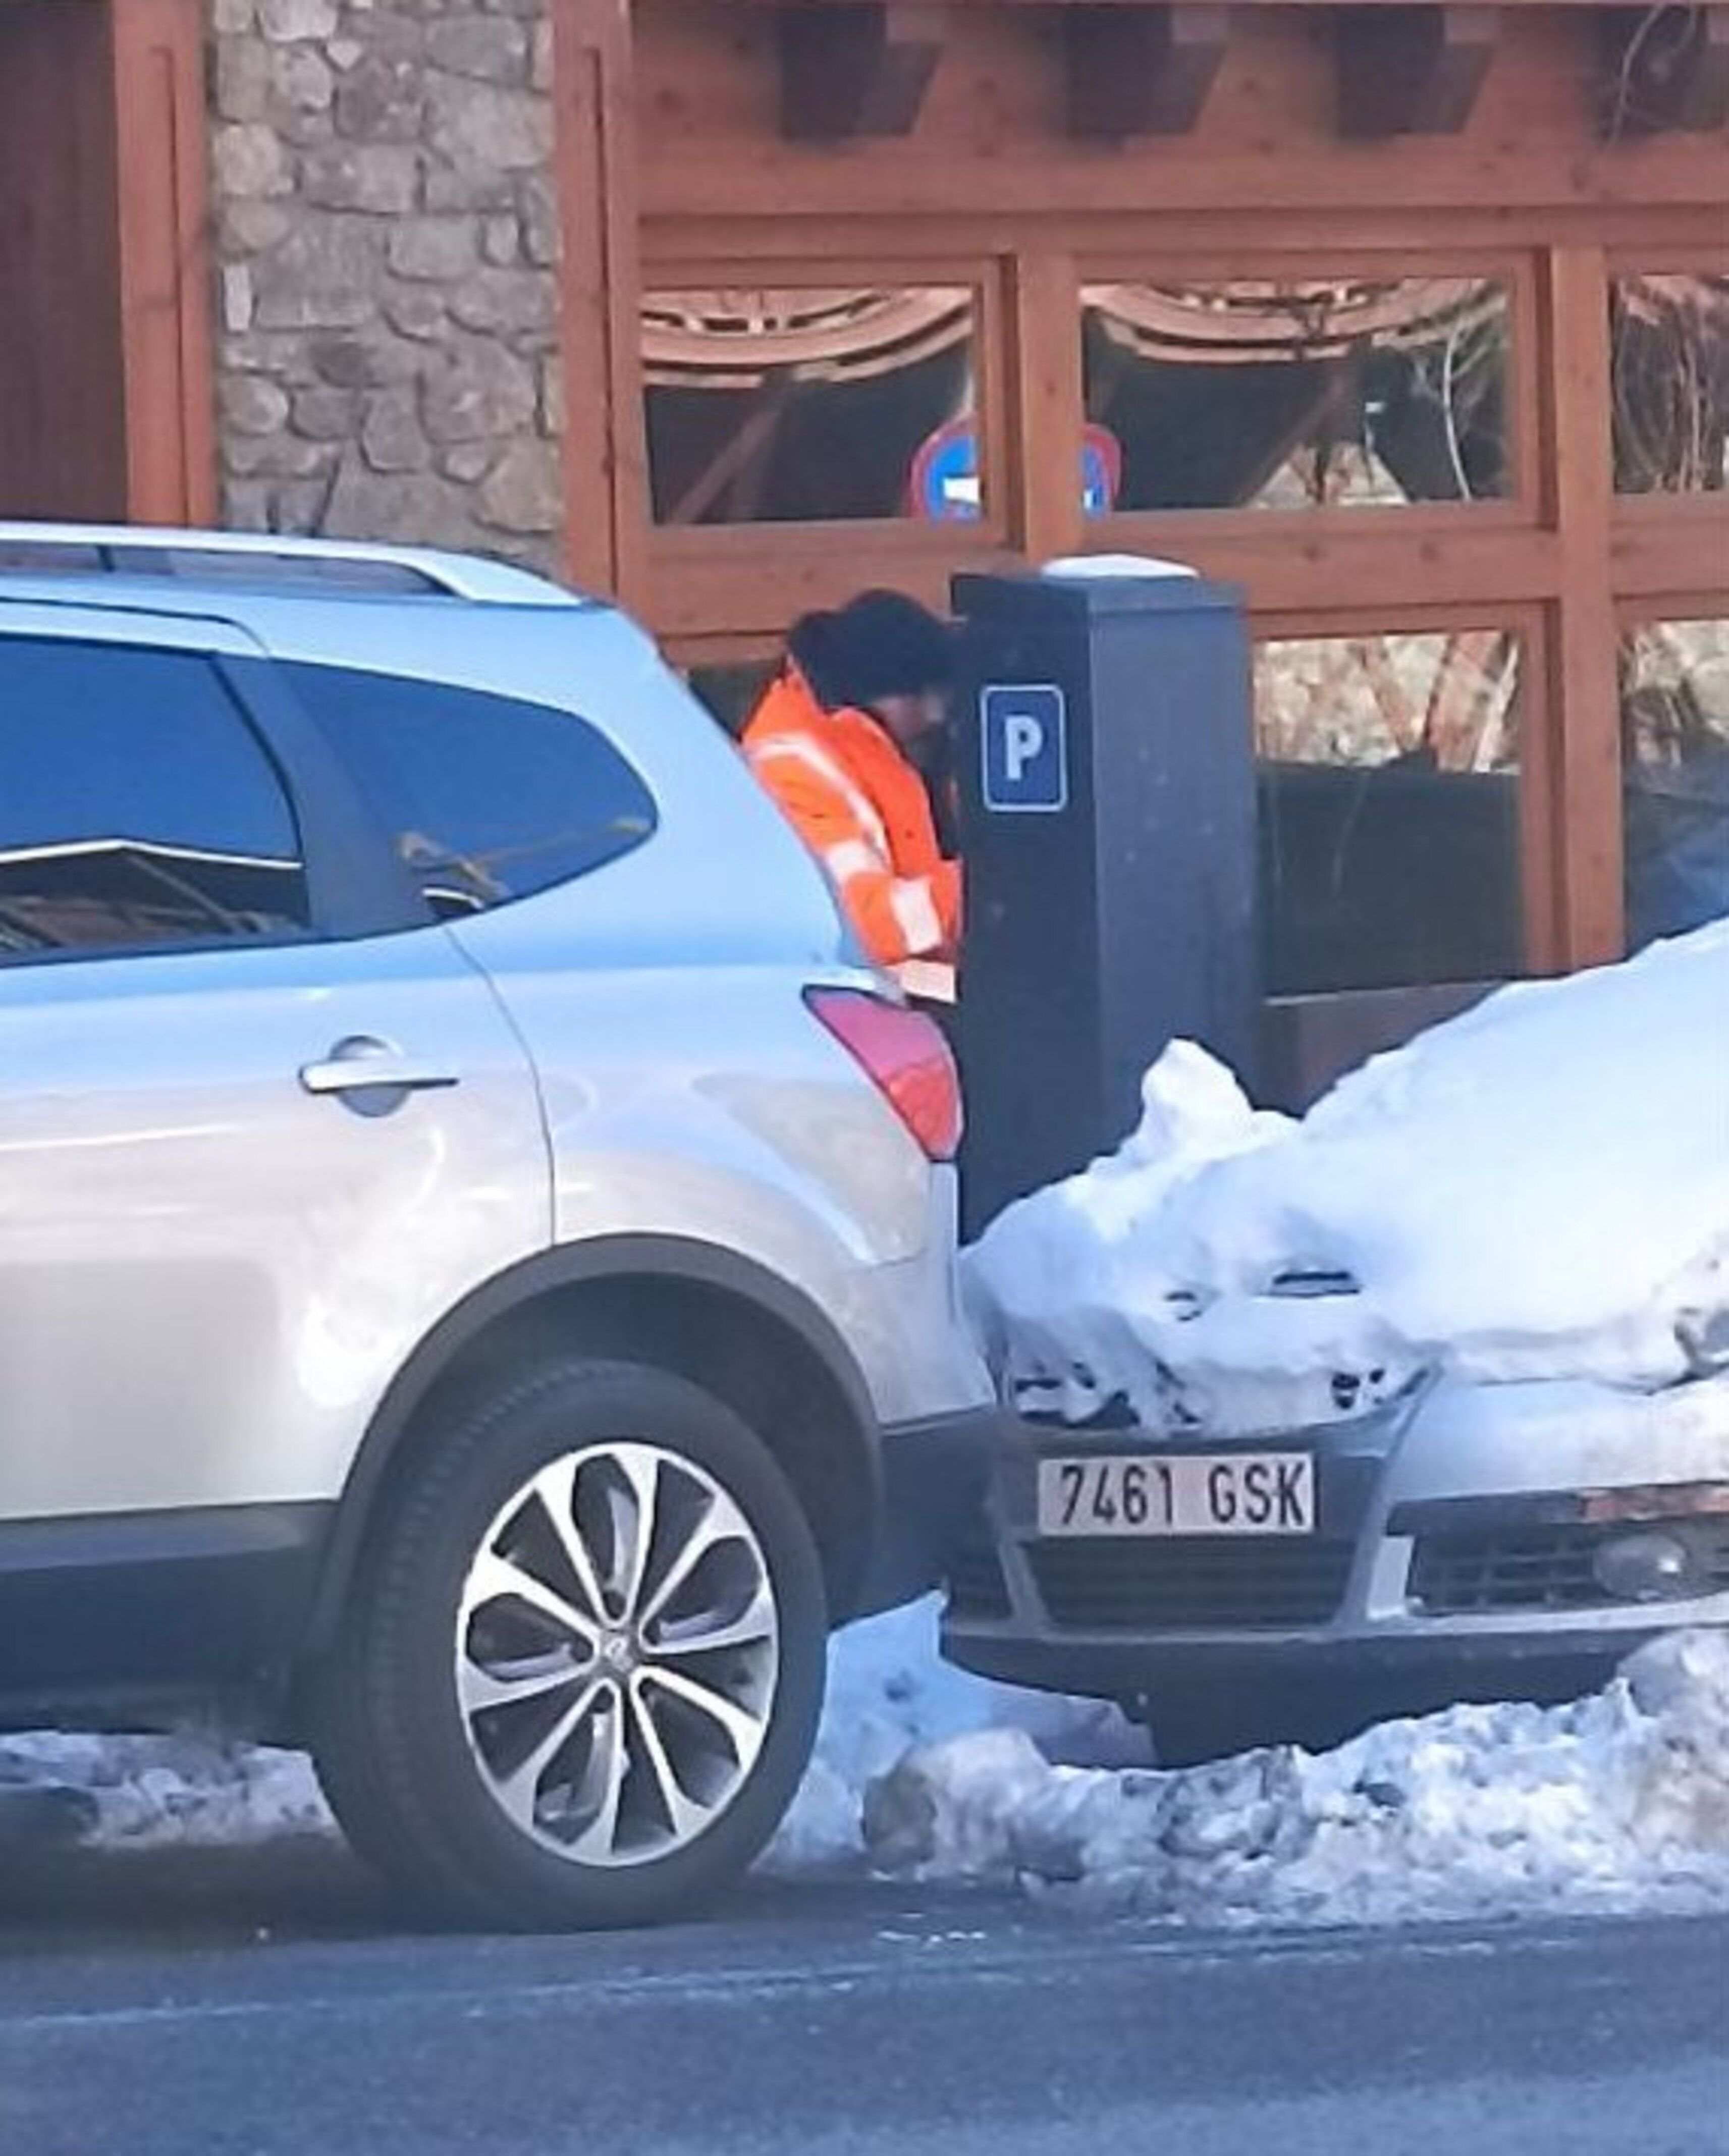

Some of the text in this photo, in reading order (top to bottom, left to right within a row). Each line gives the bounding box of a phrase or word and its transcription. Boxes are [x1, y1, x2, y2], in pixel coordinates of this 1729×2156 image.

[1005, 714, 1043, 780] P
[1061, 1463, 1304, 1525] 7461 GSK
